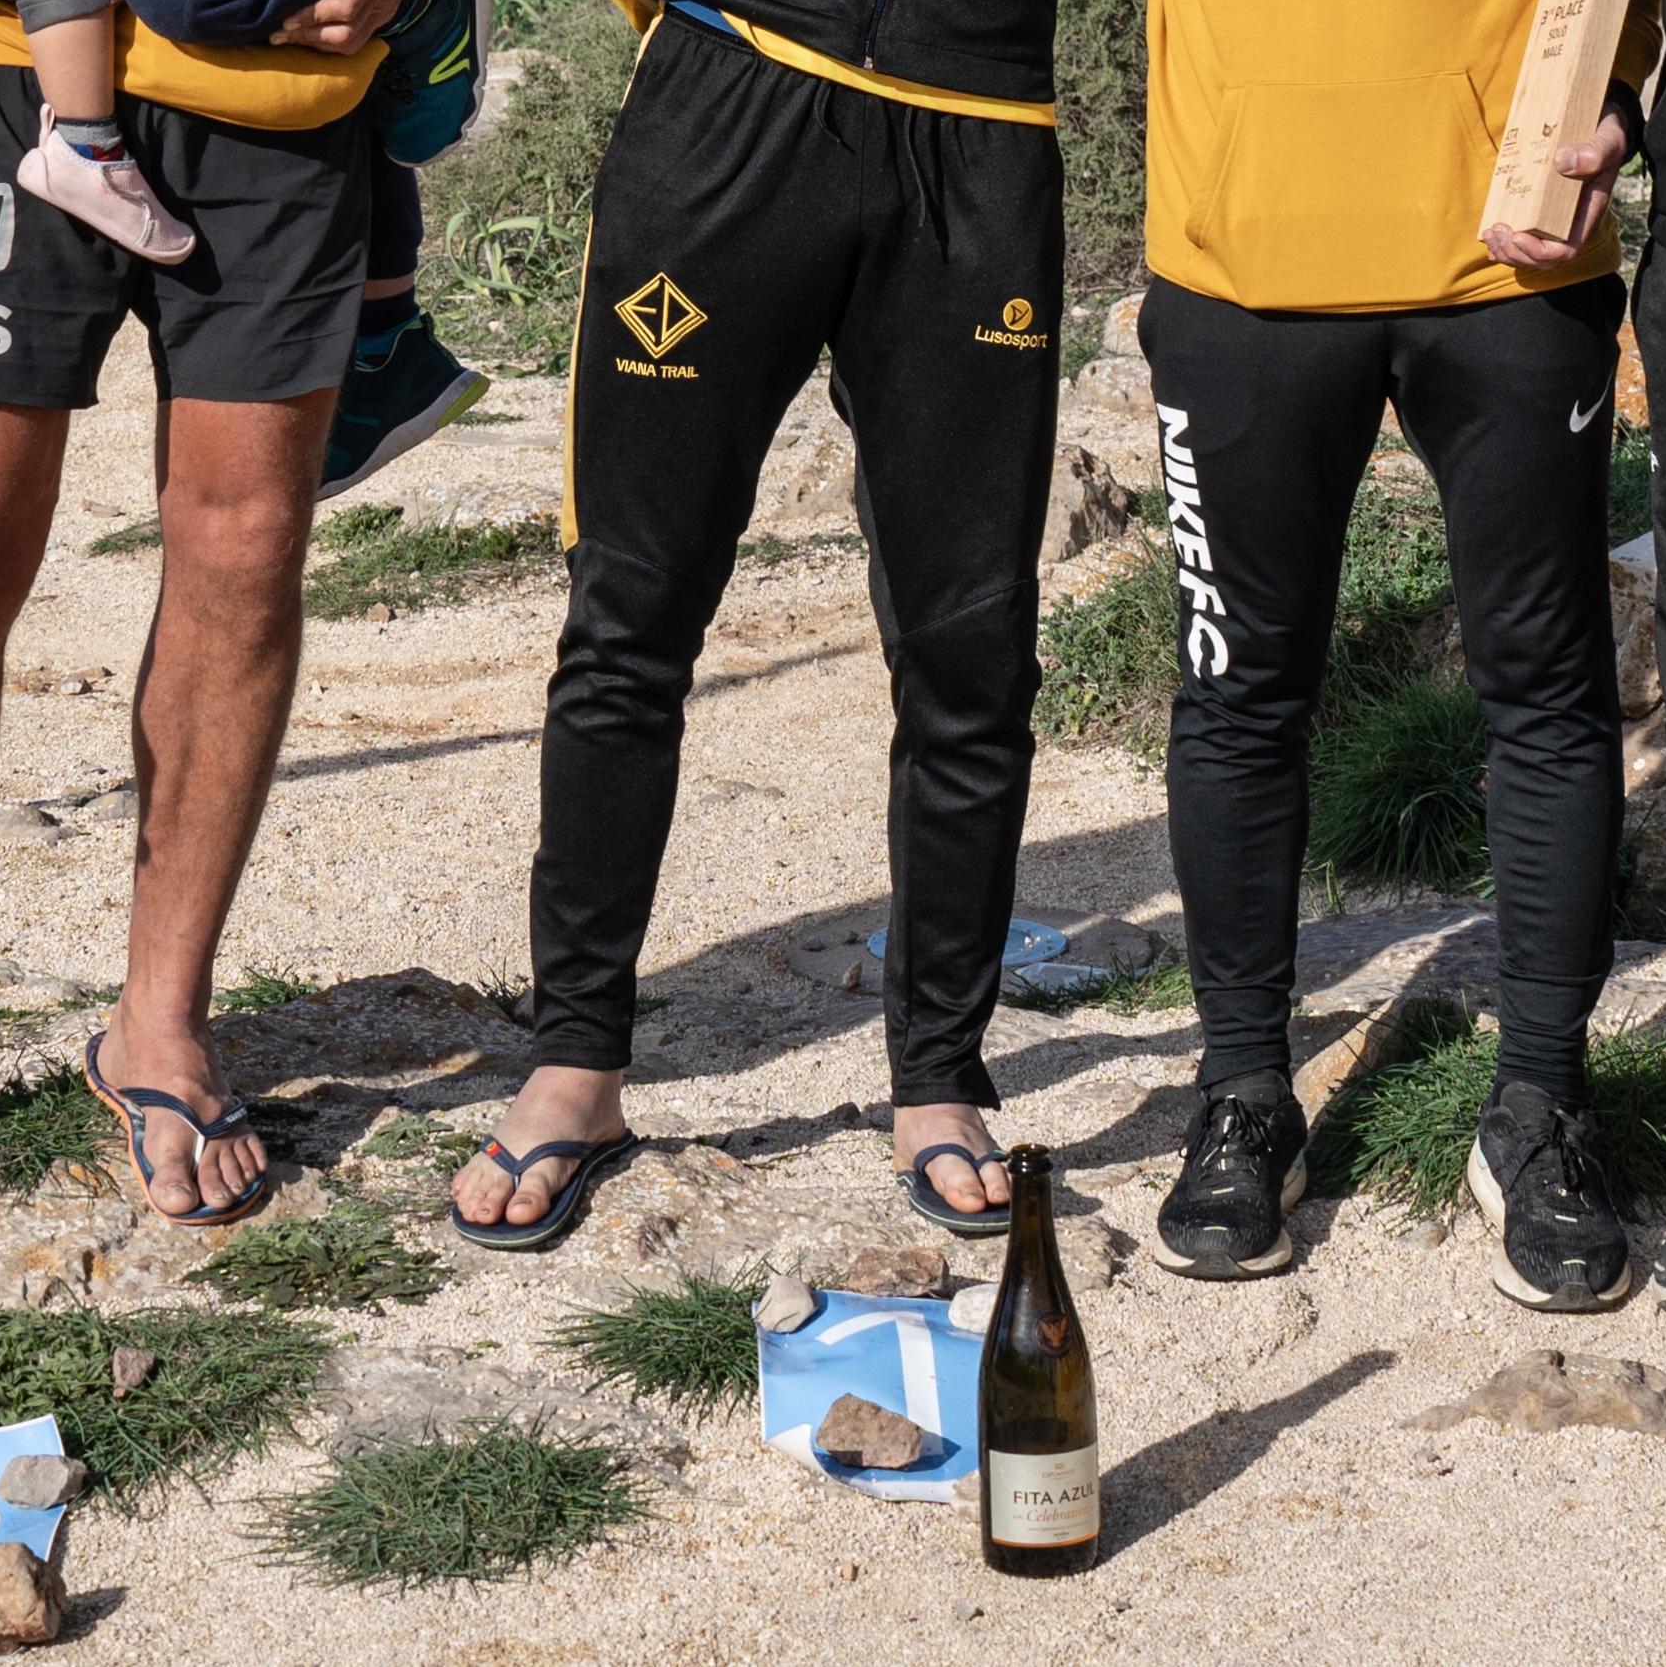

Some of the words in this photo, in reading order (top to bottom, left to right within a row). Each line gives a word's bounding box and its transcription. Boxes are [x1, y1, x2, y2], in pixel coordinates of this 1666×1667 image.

[1554, 0, 1586, 21] PLACE
[1548, 24, 1568, 41] SOLO
[1542, 43, 1564, 60] MALE
[974, 324, 1048, 351] Lusosport
[616, 357, 657, 377] VIANA
[660, 365, 700, 379] TRAIL
[1156, 402, 1214, 572] NIKE
[815, 1310, 945, 1456] 1
[1013, 1490, 1054, 1505] FITA
[1058, 1481, 1095, 1504] AZUL
